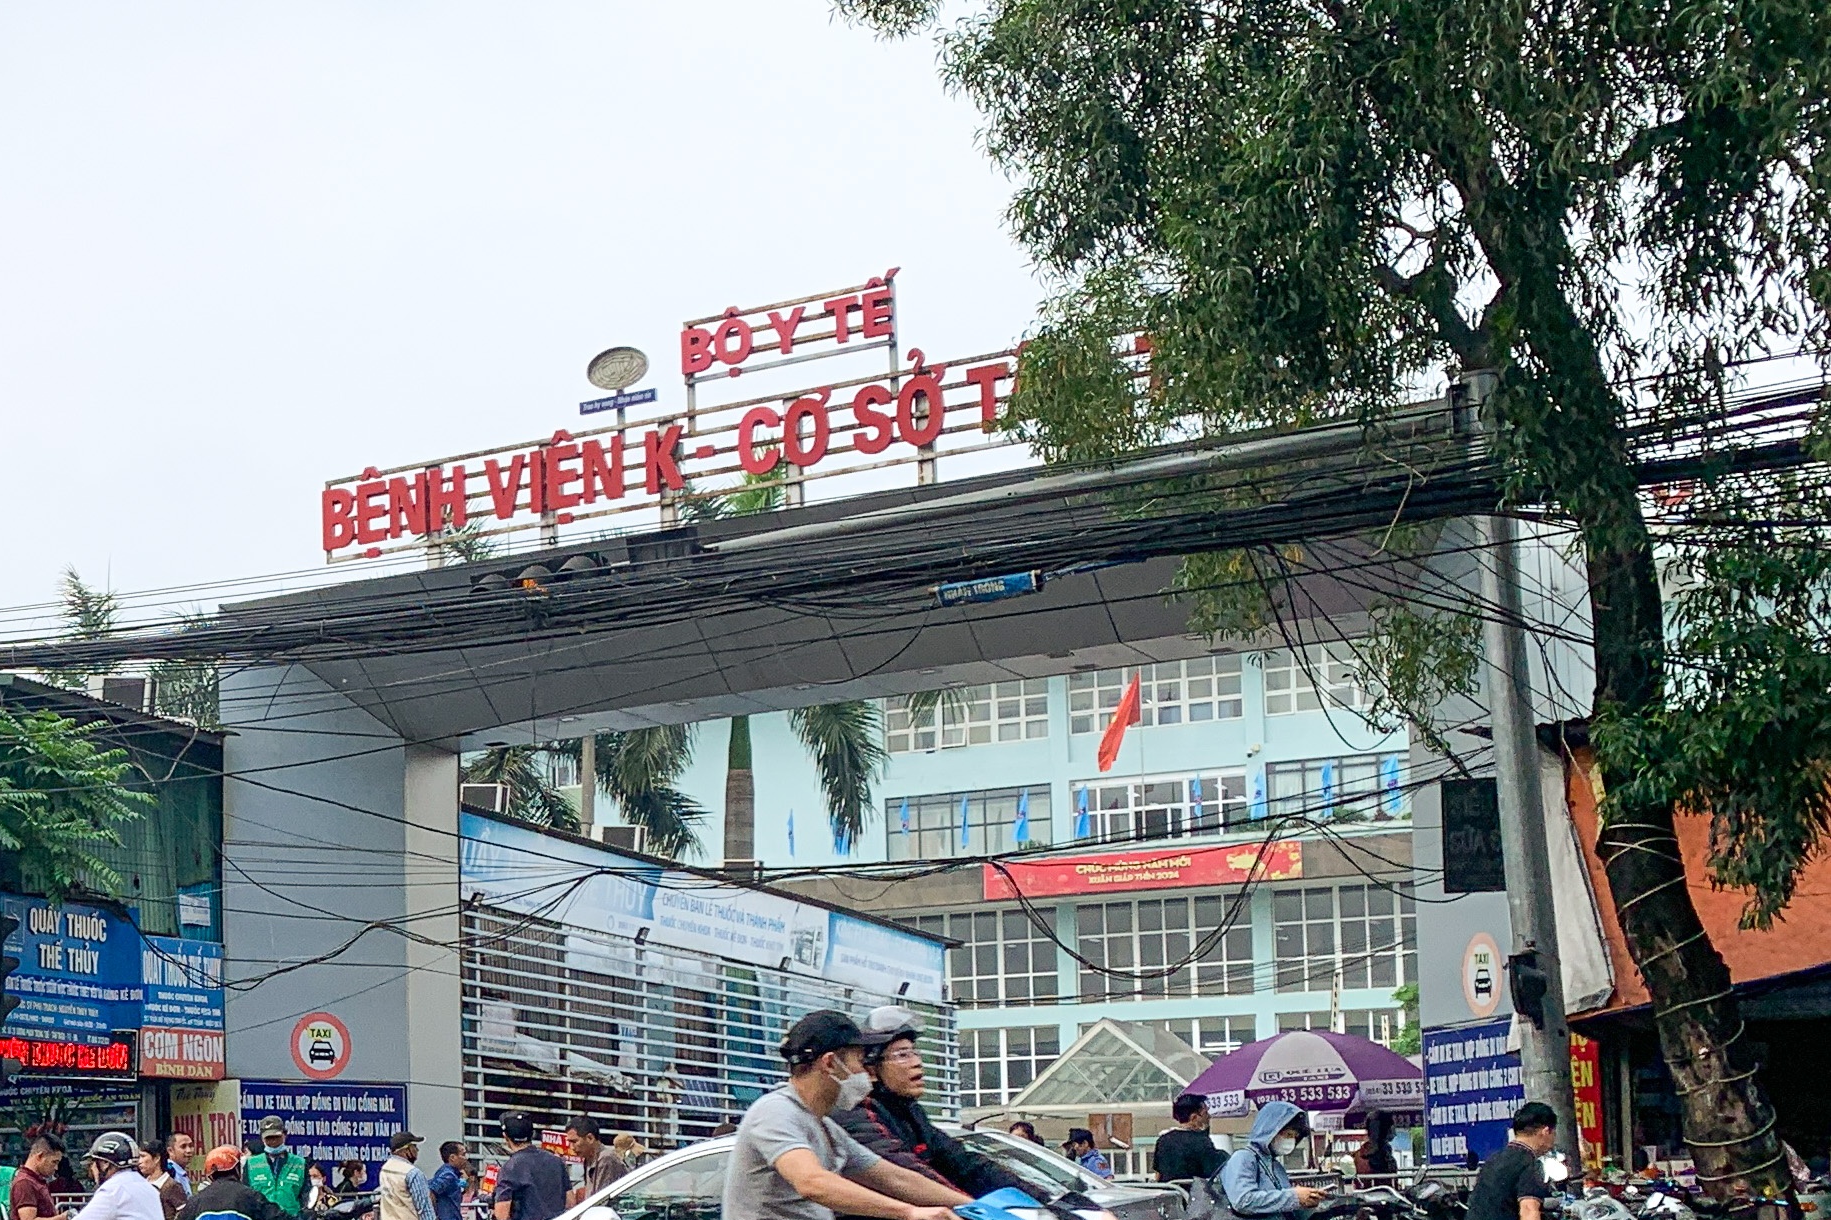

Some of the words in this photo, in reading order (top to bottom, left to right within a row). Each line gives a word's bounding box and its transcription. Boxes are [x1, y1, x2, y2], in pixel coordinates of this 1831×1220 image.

[681, 306, 755, 378] BỘ
[768, 304, 807, 356] Y
[823, 266, 903, 345] TẾ
[323, 466, 468, 559] BỆNH
[483, 427, 625, 525] VIỆN
[645, 424, 687, 496] K
[737, 384, 834, 477] CƠ
[852, 347, 948, 456] SỞ
[66, 910, 108, 943] THUỐC
[39, 938, 64, 971] THẾ
[67, 942, 100, 975] THỦY
[1474, 952, 1490, 965] TAXI
[143, 1030, 179, 1061] CƠM
[309, 1028, 333, 1039] TAXI
[256, 1094, 264, 1110] ĐI
[265, 1095, 275, 1110] XE
[311, 1091, 333, 1112] ĐỒNG
[342, 1093, 357, 1111] VÀO
[1280, 1088, 1298, 1102] 33
[1299, 1087, 1324, 1101] 533
[1326, 1085, 1351, 1100] 533
[315, 1117, 330, 1136] VÀO
[352, 1121, 358, 1136] 2
[358, 1121, 374, 1137] CHU
